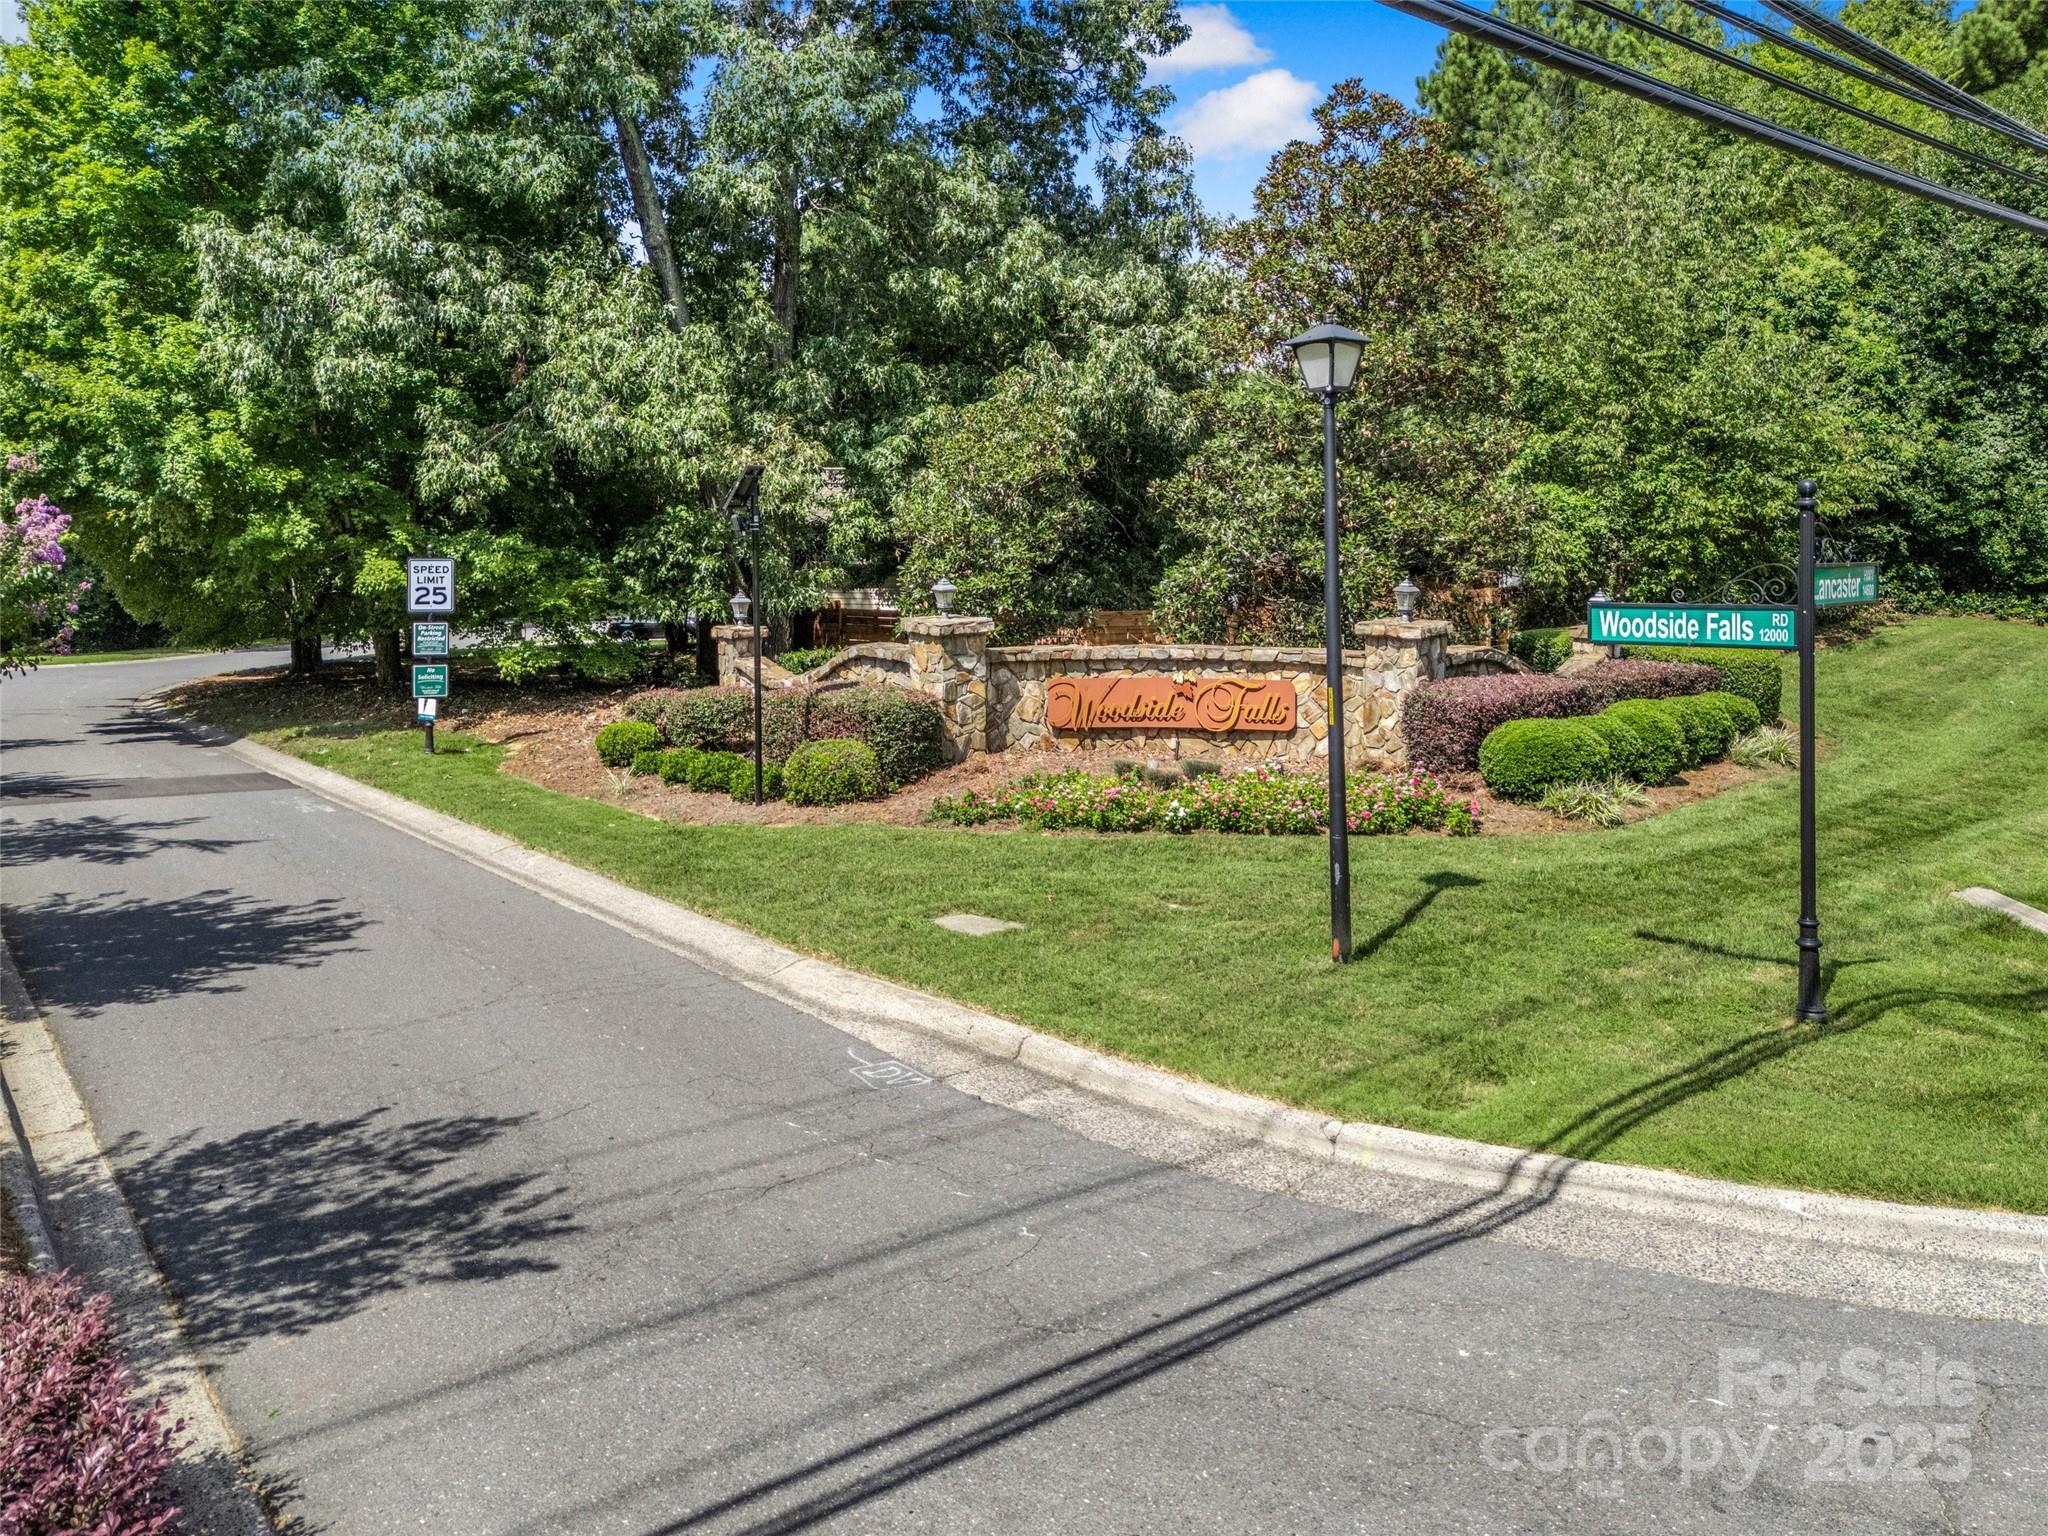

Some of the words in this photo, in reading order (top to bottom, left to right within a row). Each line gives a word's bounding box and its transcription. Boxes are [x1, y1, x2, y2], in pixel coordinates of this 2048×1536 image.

[413, 565, 449, 574] SPEED
[416, 576, 445, 584] LIMIT
[415, 587, 447, 605] 25
[1600, 610, 1699, 640] Woodside
[1706, 612, 1754, 642] Falls
[1772, 614, 1788, 627] RD
[1759, 628, 1788, 642] 12000
[417, 673, 444, 681] Soliciting
[1047, 678, 1186, 731] Woodside
[1194, 678, 1290, 732] Falls
